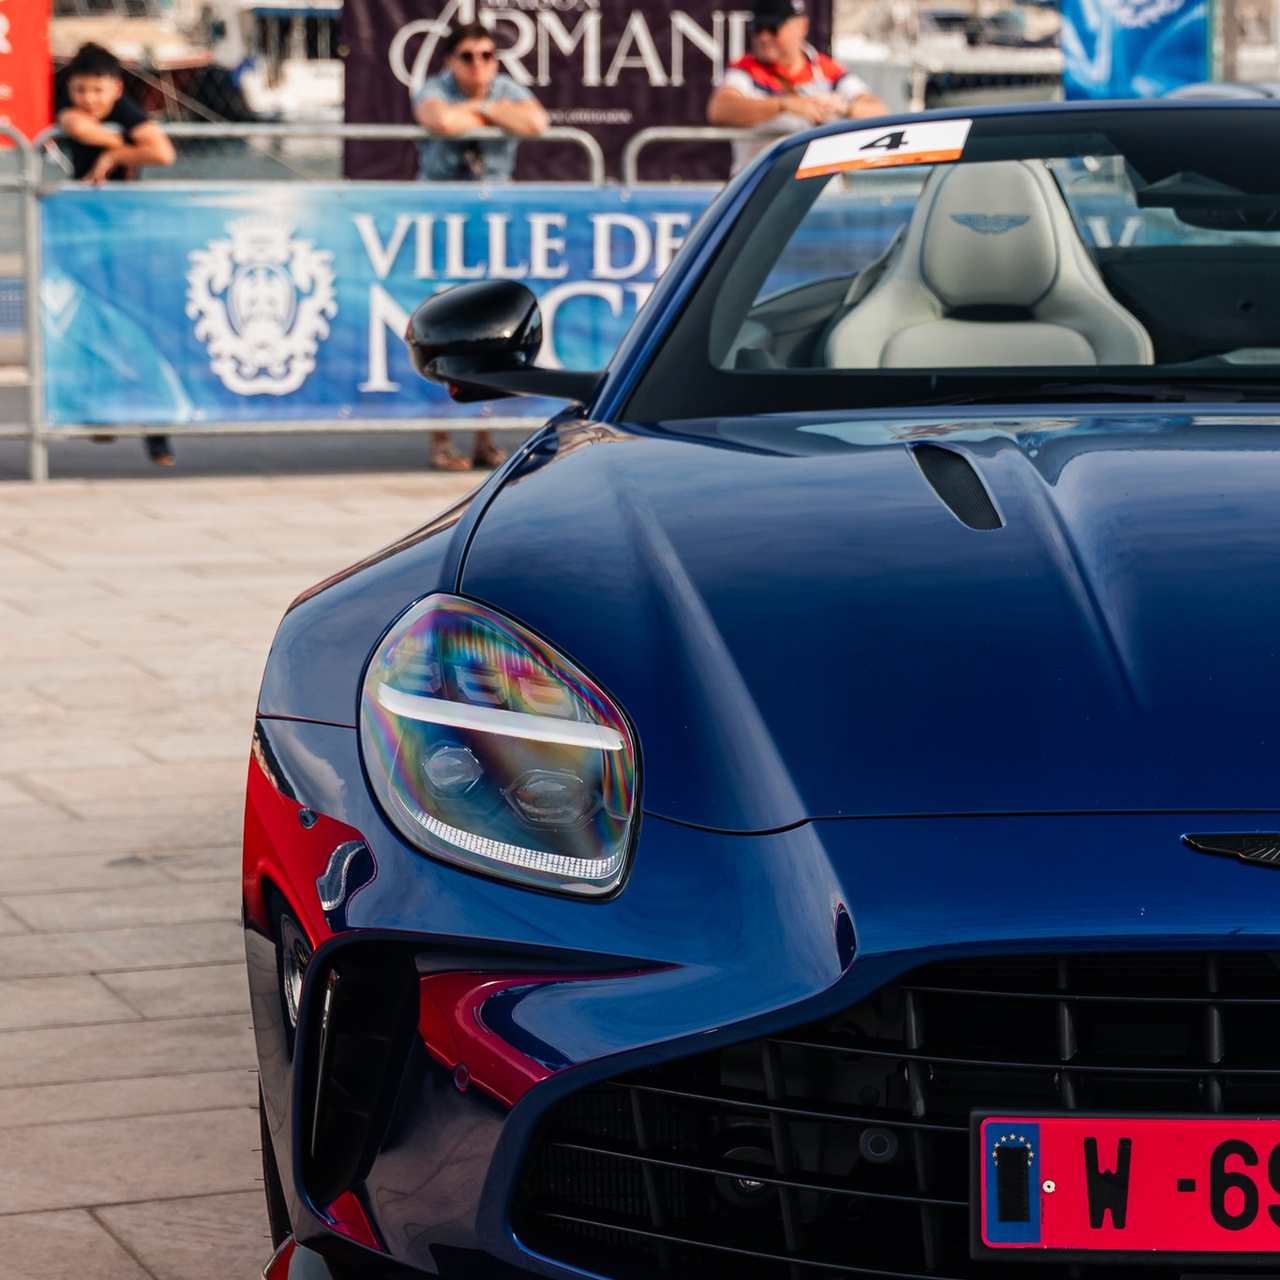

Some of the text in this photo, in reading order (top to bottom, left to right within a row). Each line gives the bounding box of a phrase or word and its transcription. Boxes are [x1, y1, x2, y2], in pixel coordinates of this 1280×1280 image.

[859, 130, 908, 152] 4
[353, 212, 693, 280] VILLE DE
